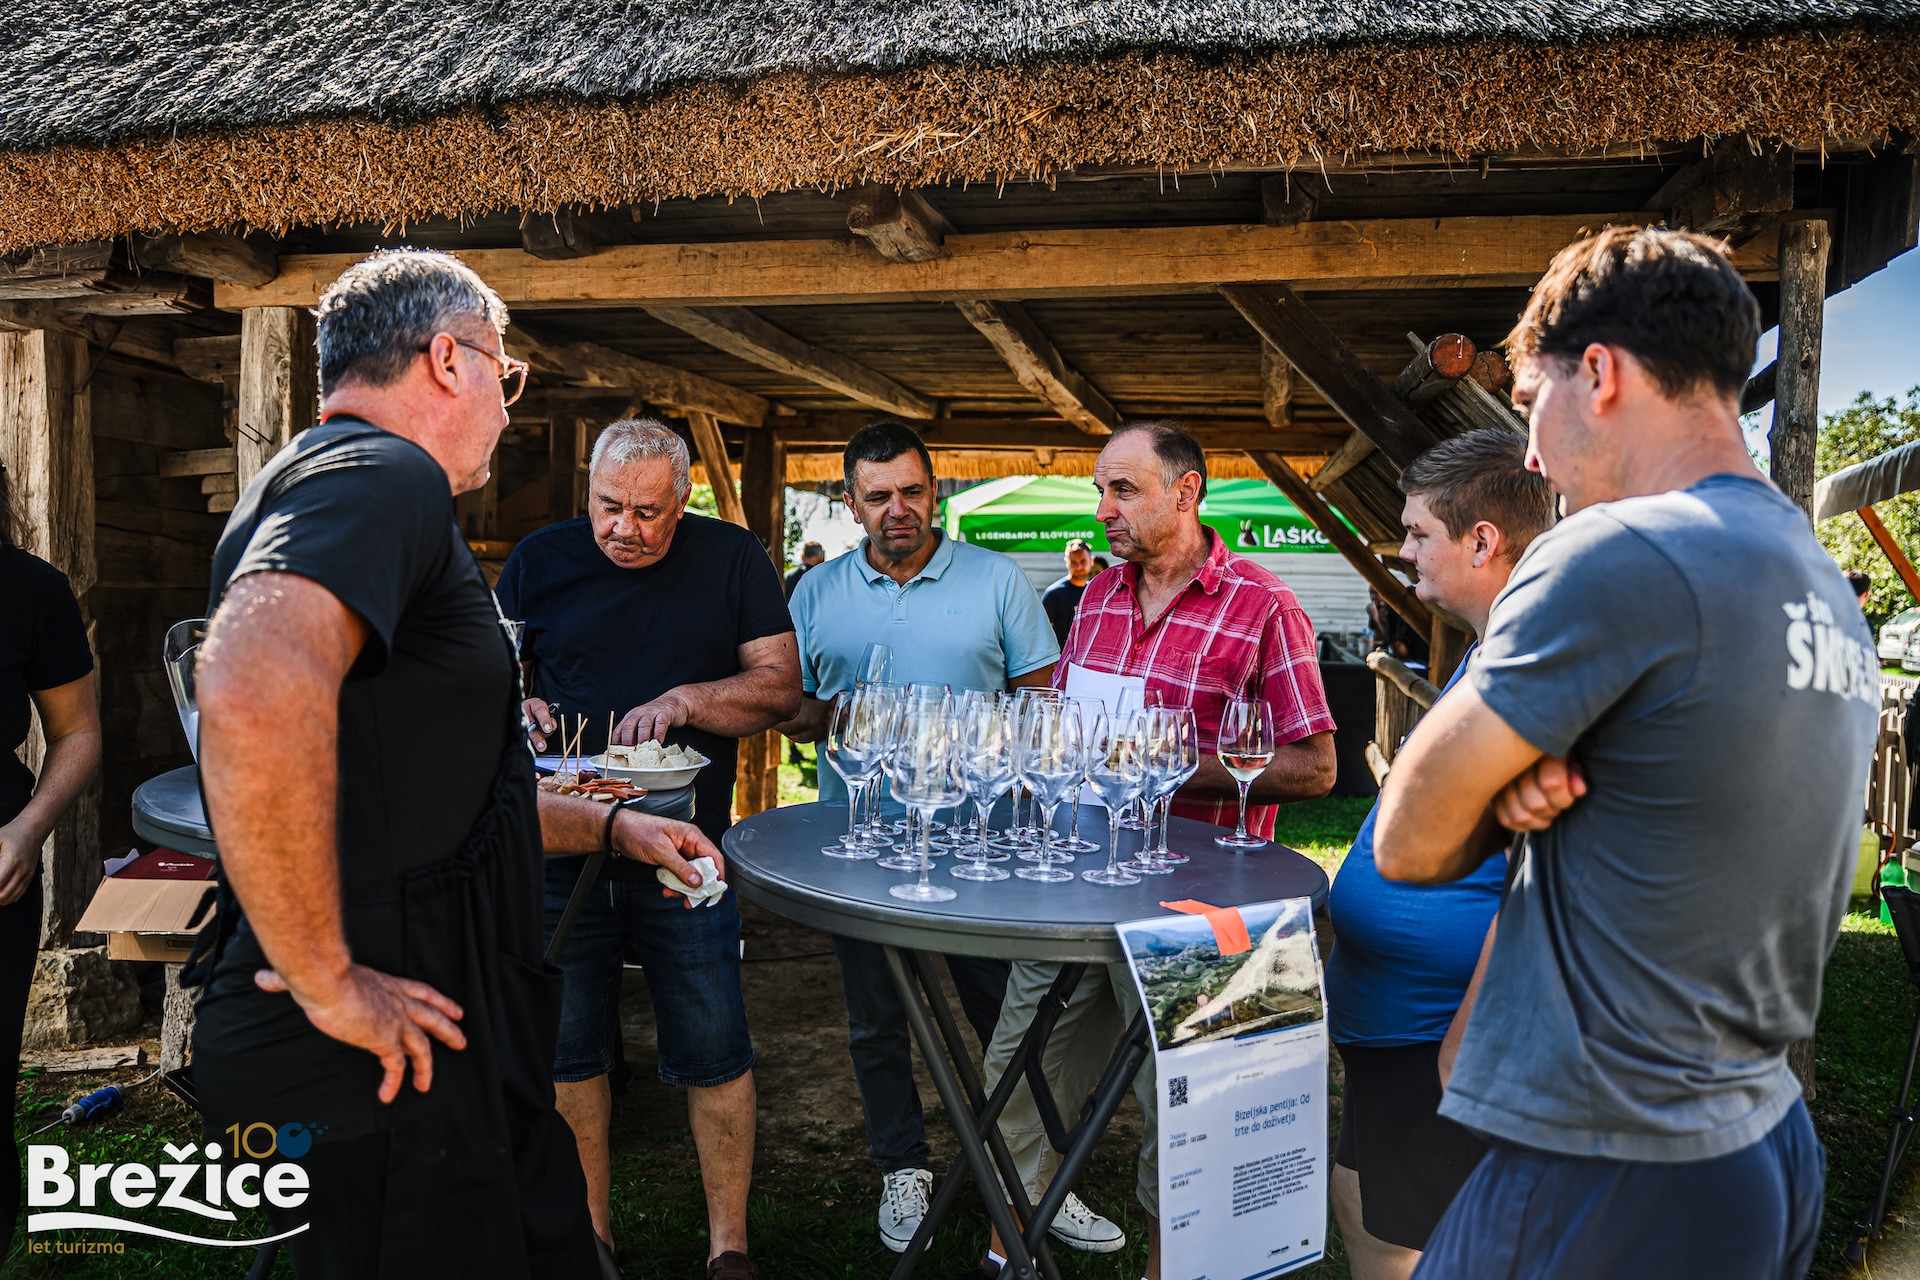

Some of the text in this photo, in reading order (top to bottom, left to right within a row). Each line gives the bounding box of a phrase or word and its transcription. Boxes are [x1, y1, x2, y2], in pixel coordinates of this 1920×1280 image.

[975, 530, 1095, 540] LEGENDARNO SLOVENSKO
[1234, 1104, 1268, 1122] Bizeljska
[1299, 1093, 1311, 1105] Od
[1234, 1112, 1296, 1137] trte do doživetja
